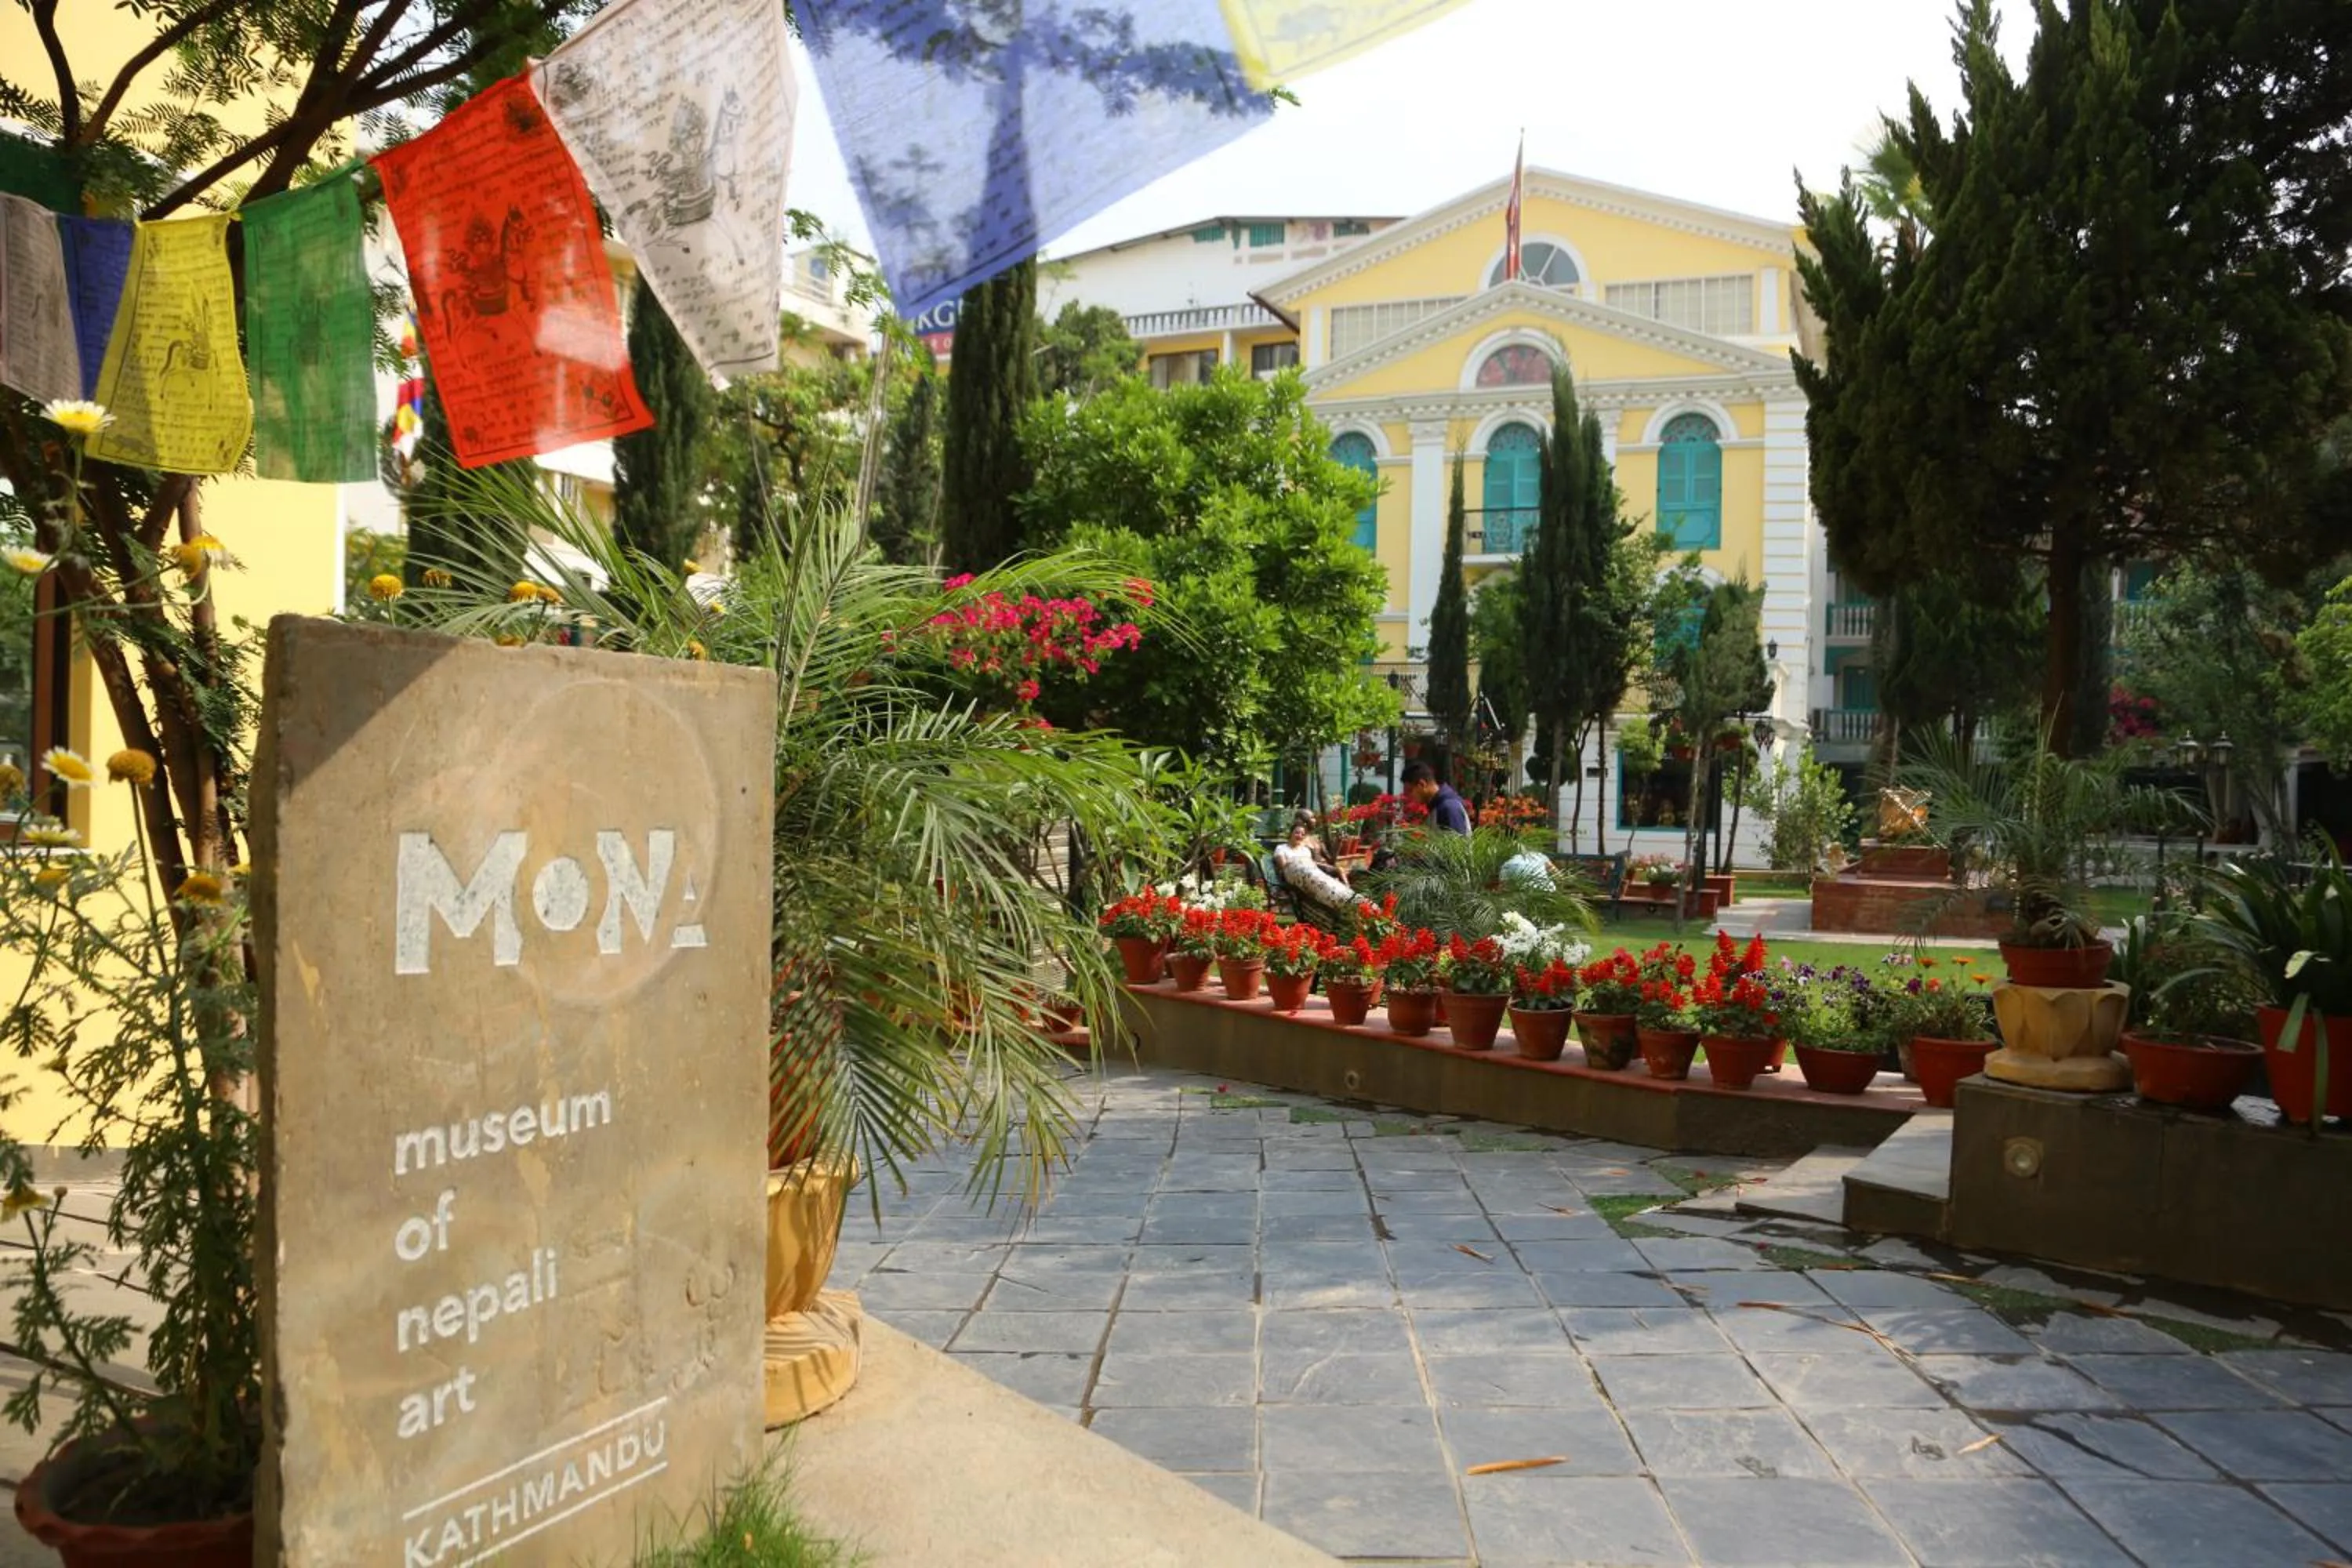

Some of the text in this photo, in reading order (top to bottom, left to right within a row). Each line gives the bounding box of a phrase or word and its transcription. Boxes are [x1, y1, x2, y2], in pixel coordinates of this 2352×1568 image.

[394, 1091, 612, 1176] museum
[394, 1187, 456, 1261] of
[397, 1247, 557, 1353] nepali
[397, 1365, 477, 1439] art
[404, 1420, 666, 1568] KATHMANDU
